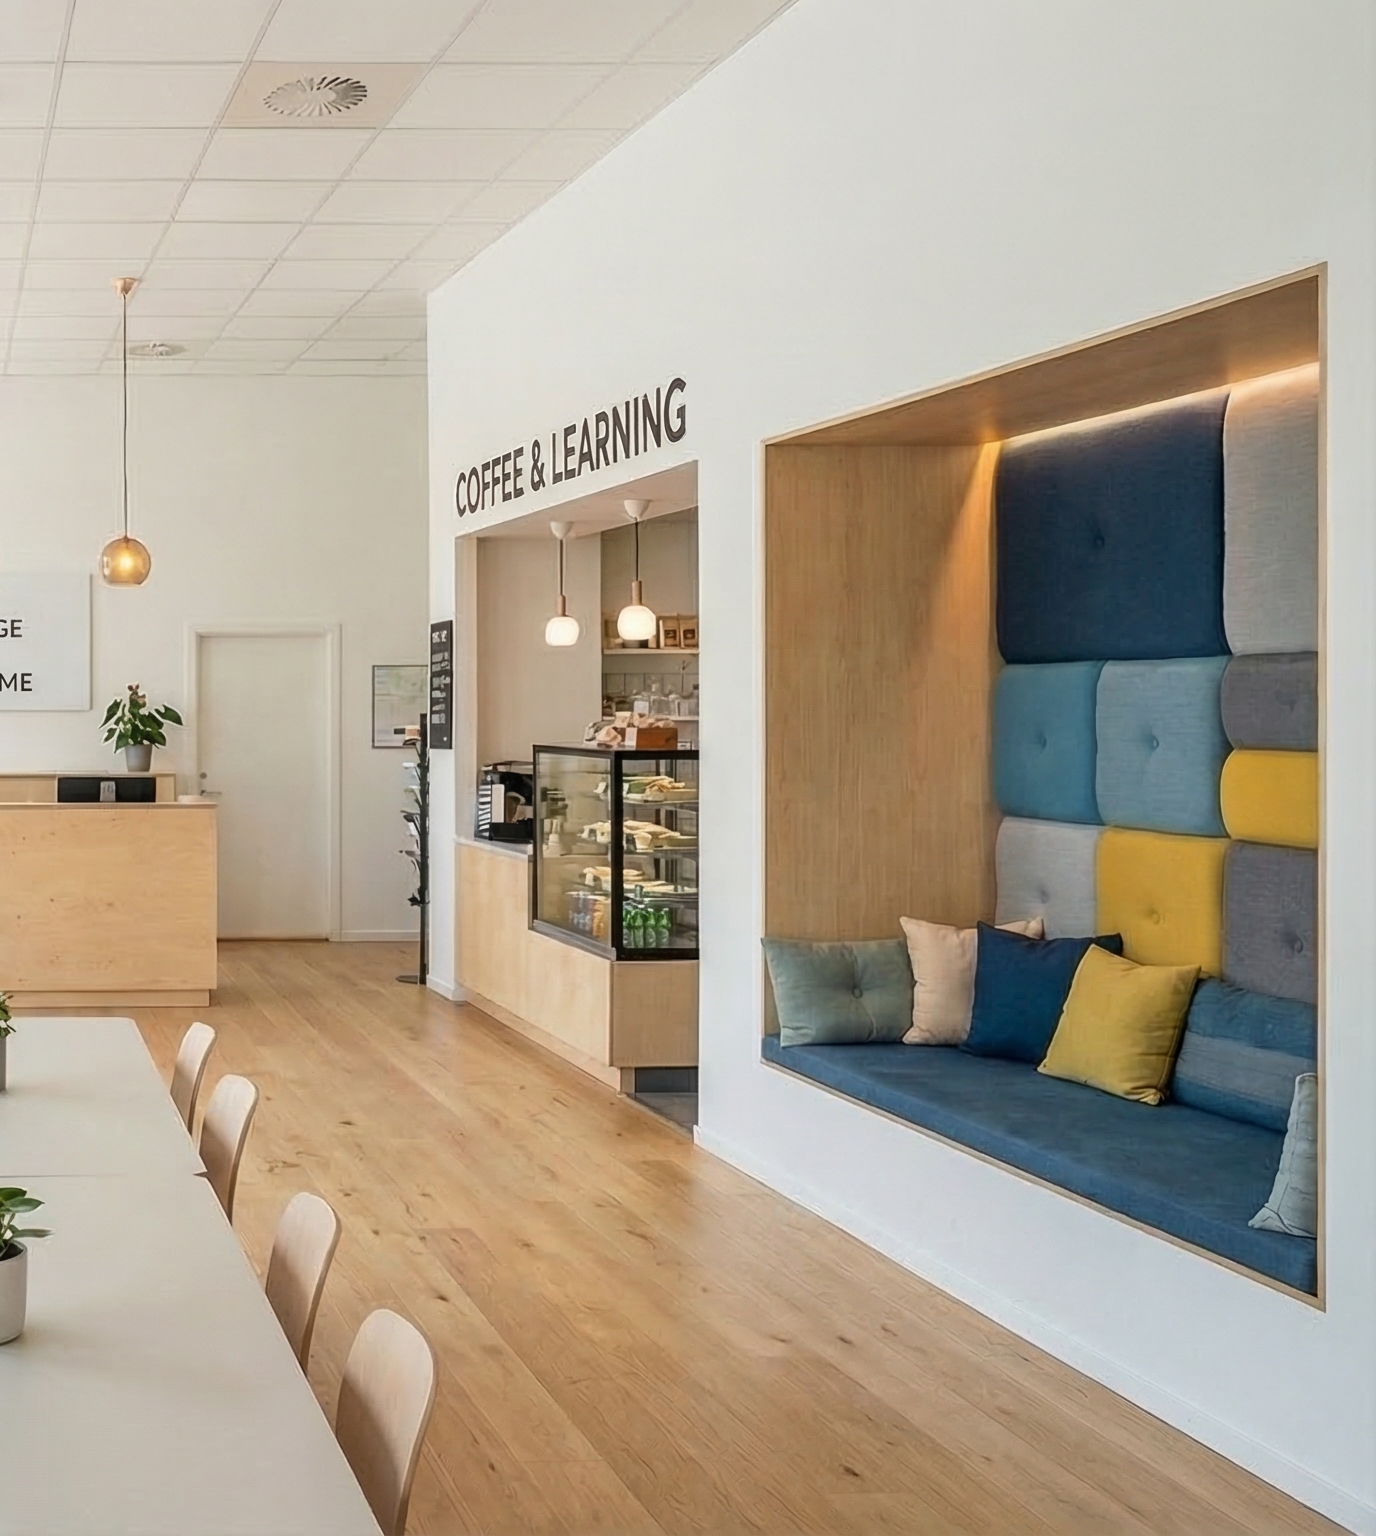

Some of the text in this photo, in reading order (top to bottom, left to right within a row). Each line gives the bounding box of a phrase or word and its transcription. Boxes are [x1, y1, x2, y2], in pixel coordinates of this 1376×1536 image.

[455, 377, 687, 518] COFFEE & LEARNING
